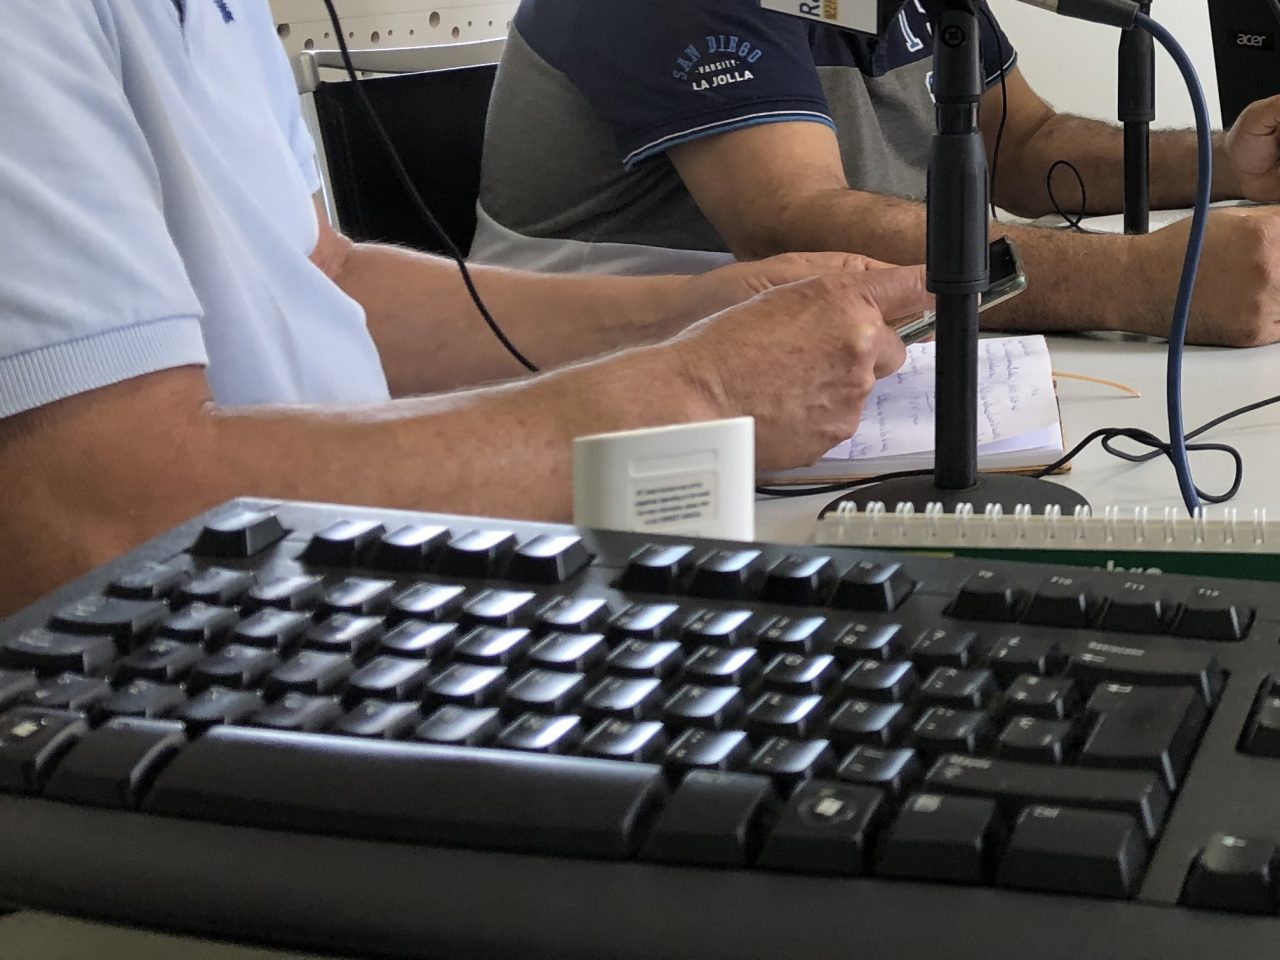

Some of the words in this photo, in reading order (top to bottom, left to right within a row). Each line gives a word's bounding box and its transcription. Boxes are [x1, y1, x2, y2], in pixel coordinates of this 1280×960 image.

[1236, 33, 1267, 47] acer
[672, 44, 702, 80] SAN
[706, 34, 762, 63] DIEGO
[691, 79, 711, 91] LA
[712, 70, 755, 88] JOLLA
